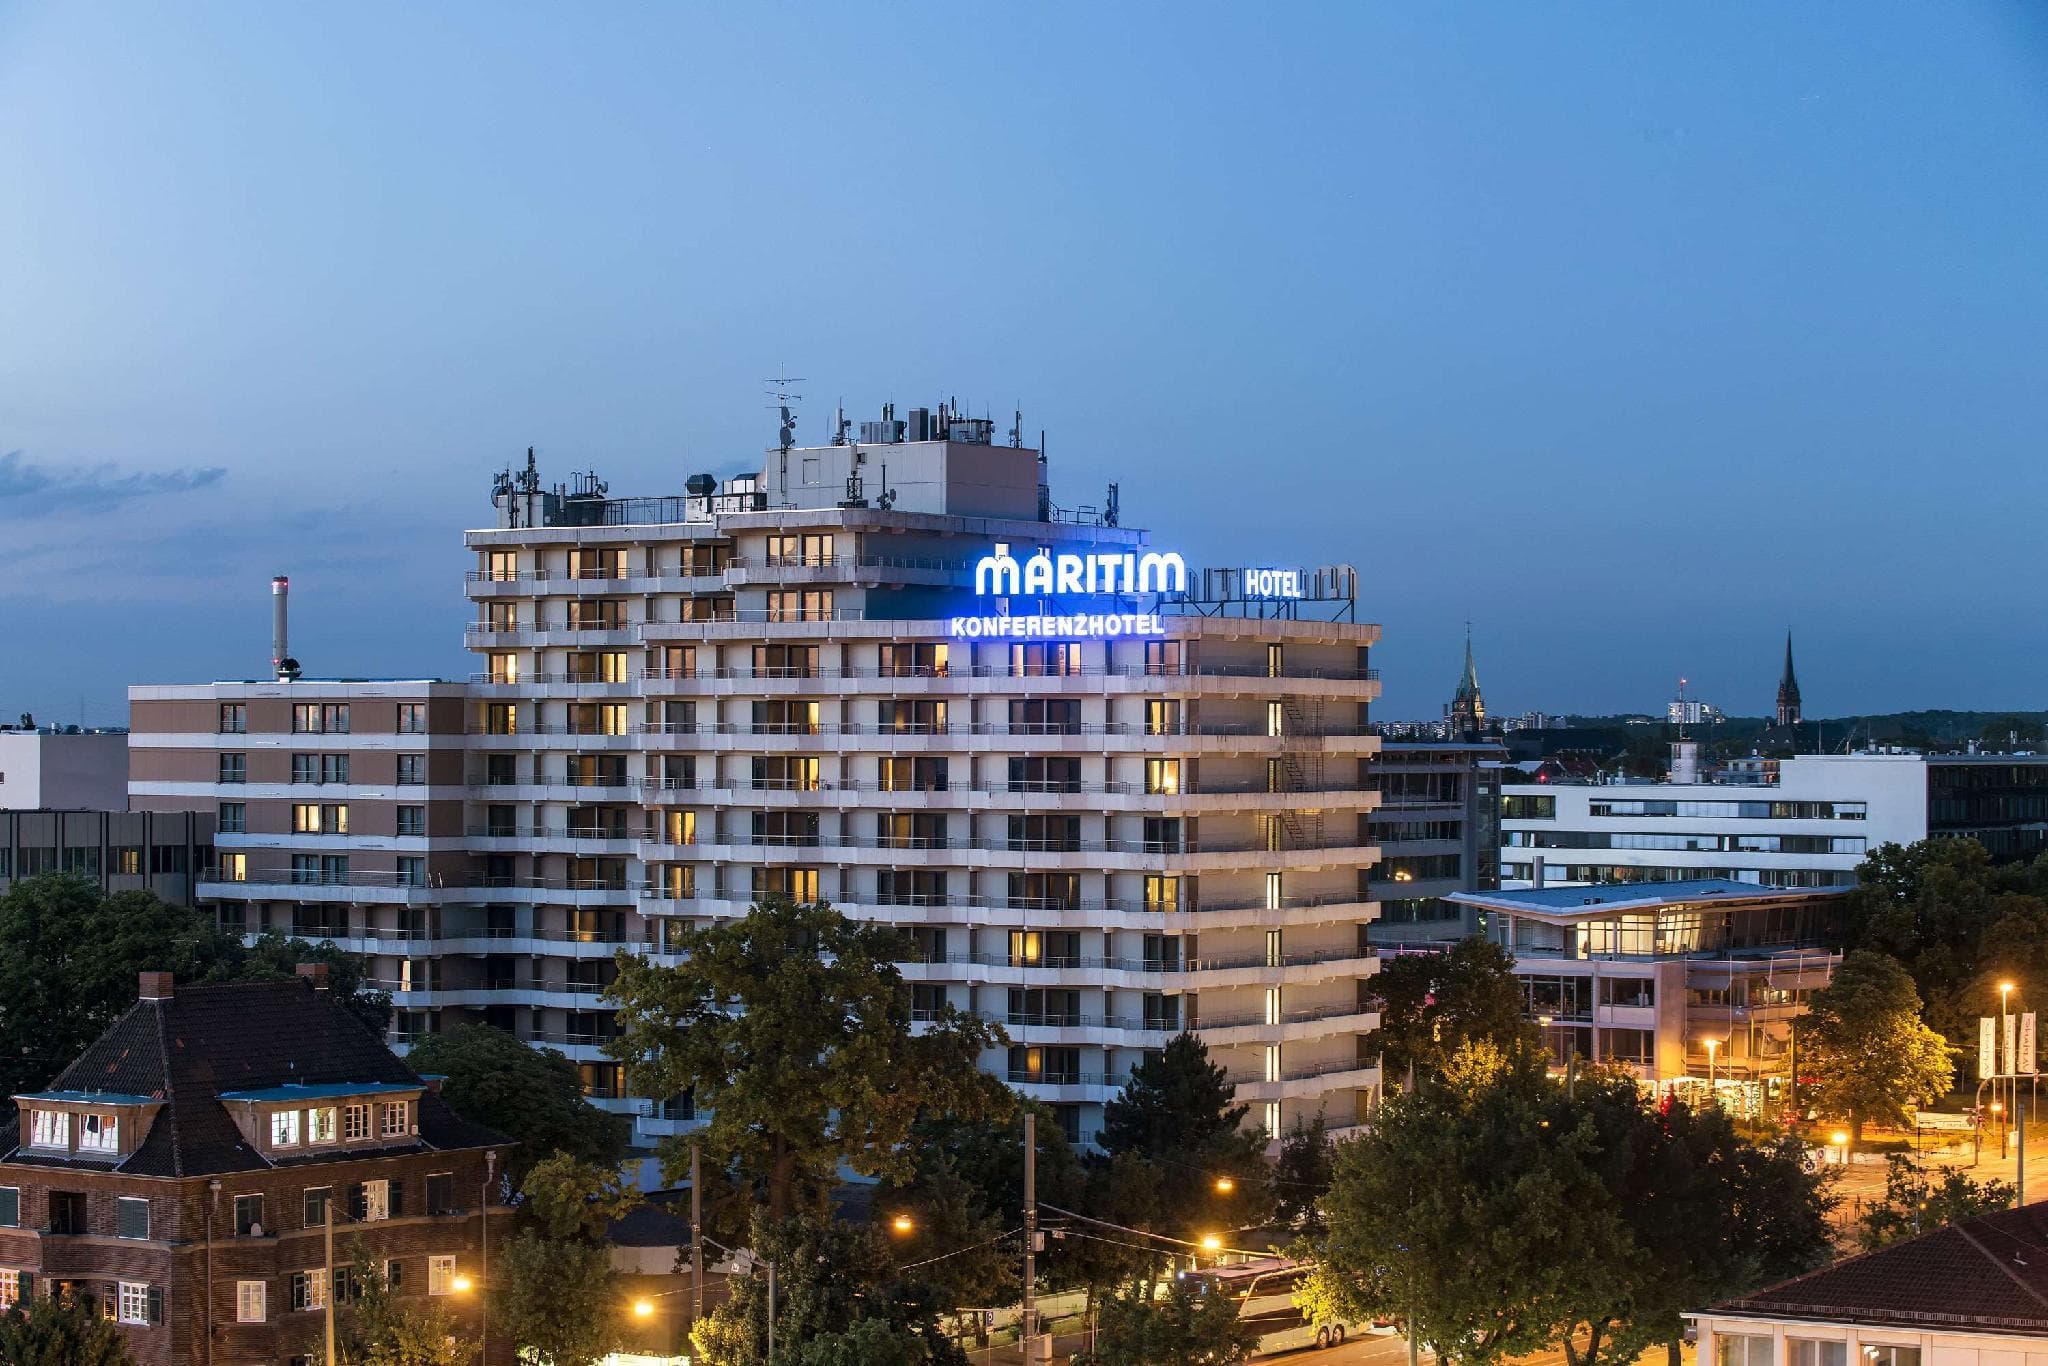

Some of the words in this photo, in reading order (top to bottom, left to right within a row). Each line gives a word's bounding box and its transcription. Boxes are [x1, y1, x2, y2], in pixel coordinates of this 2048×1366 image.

[976, 553, 1185, 595] MARITIM
[1246, 569, 1300, 598] HOTEL
[951, 614, 1165, 636] KONFERENZHOTEL
